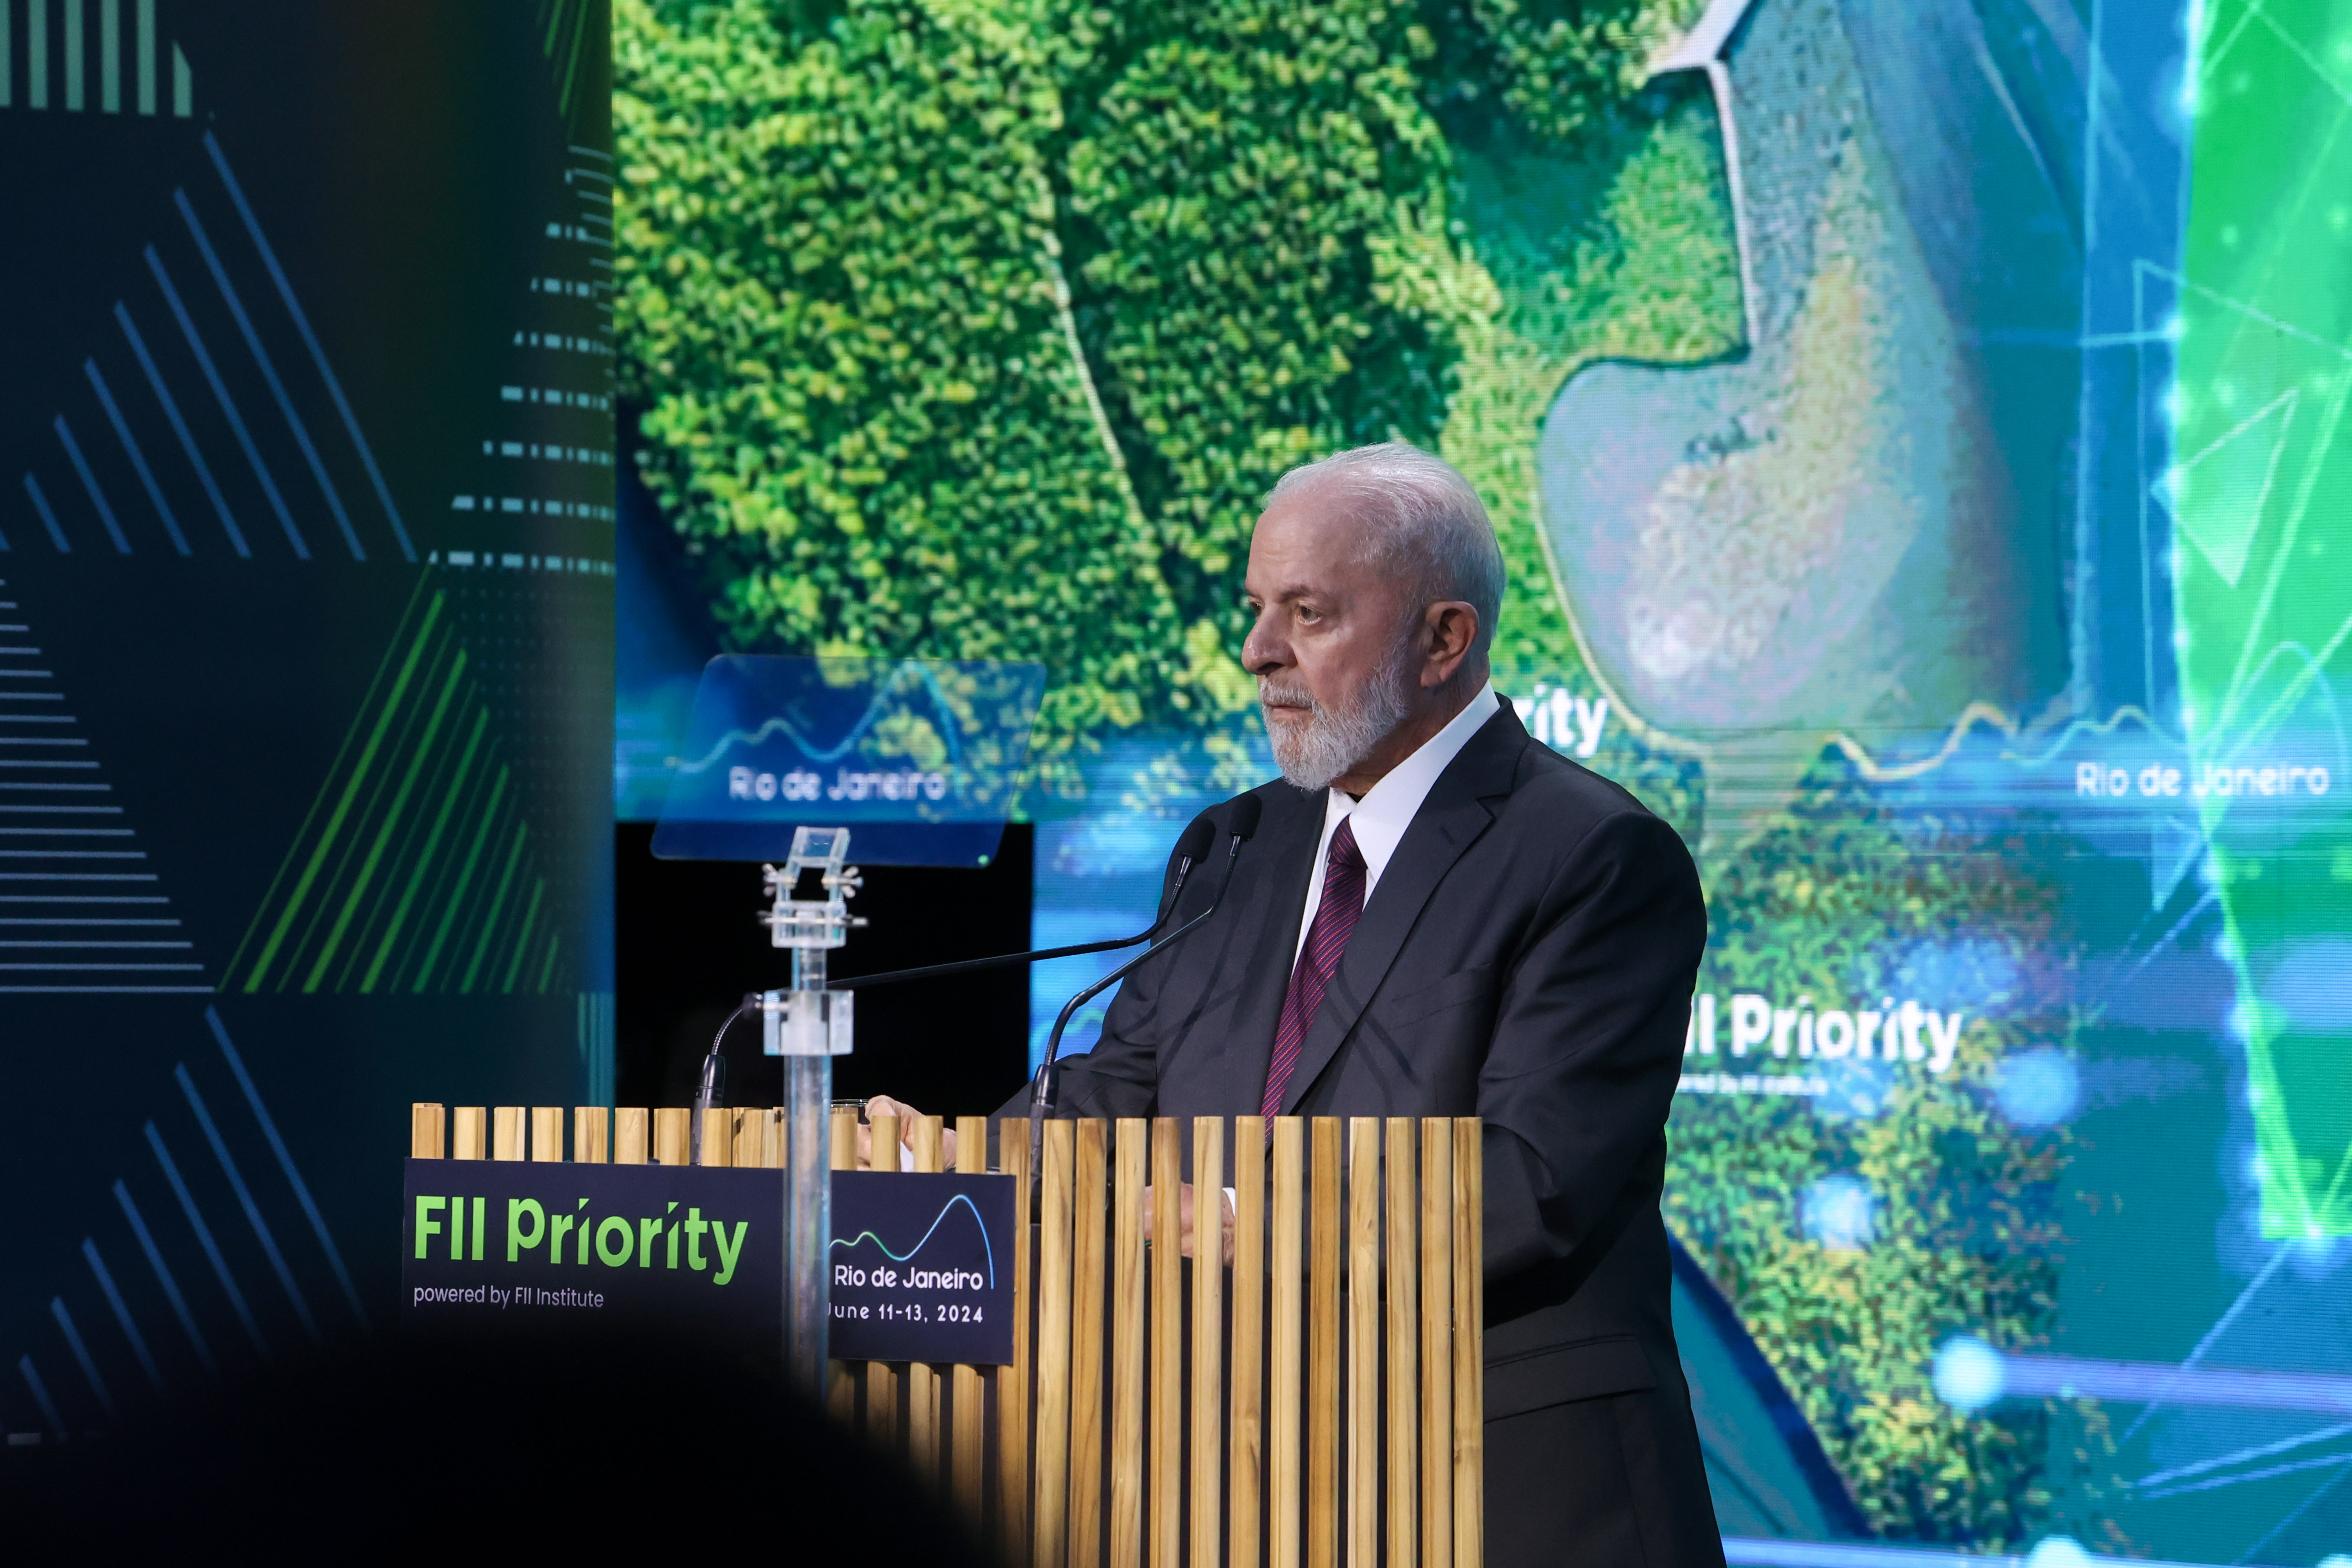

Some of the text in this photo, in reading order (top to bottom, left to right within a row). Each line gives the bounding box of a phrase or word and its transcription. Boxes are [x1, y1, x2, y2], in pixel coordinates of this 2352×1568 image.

[729, 766, 946, 801] Rio de Janeiro
[2077, 762, 2330, 796] Rio de Janeiro
[1732, 994, 1963, 1073] Priority
[415, 1196, 749, 1285] FII Priority
[835, 1265, 983, 1290] Rio de Janeiro
[414, 1285, 604, 1309] powered by FII Institute
[879, 1304, 929, 1323] 11-13,
[937, 1304, 983, 1323] 2024
